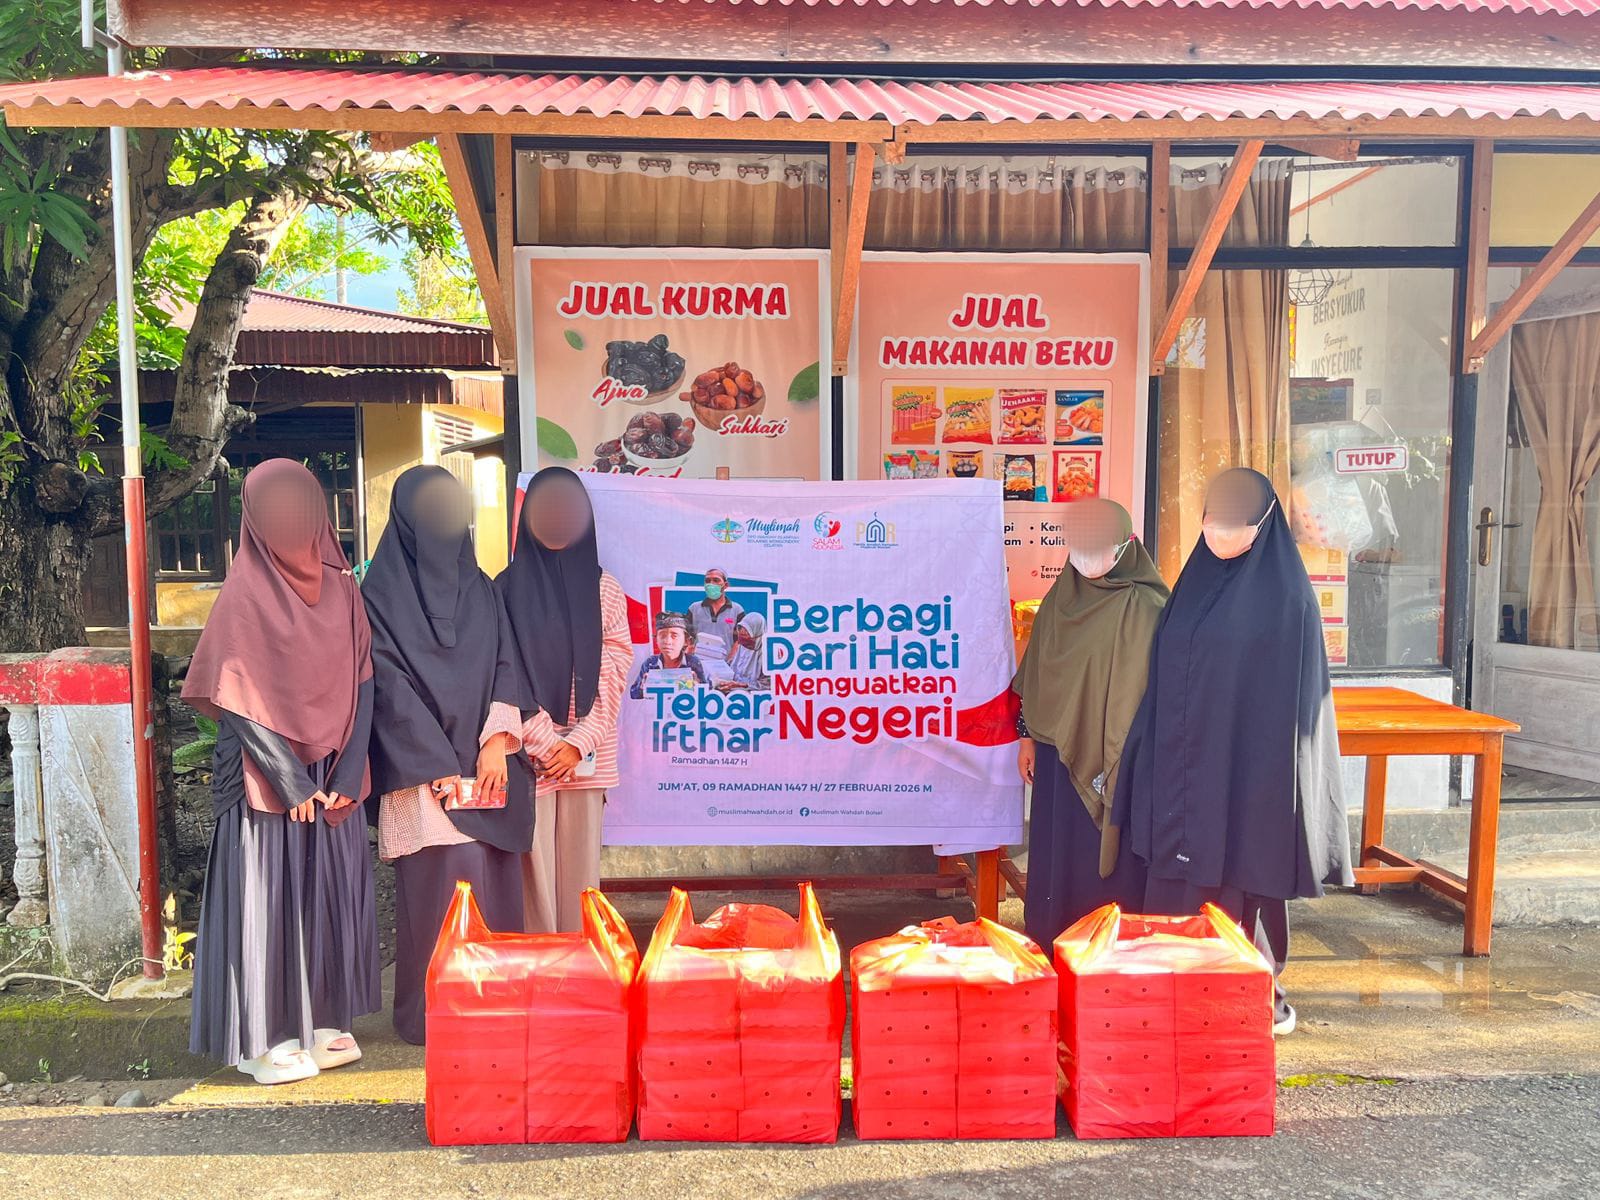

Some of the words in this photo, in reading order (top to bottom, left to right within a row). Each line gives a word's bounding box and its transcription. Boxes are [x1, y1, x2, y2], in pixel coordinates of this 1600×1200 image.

[561, 286, 653, 316] JUAL
[662, 286, 787, 316] KURMA
[952, 297, 1046, 328] JUAL
[1313, 288, 1366, 325] BERSYUKUR
[882, 340, 1027, 366] MAKANAN
[1035, 340, 1114, 367] BEKU
[592, 379, 645, 407] Ajwa
[719, 416, 788, 436] Sukkari
[1346, 452, 1396, 466] TUTUP
[1041, 536, 1065, 546] Kulit
[773, 595, 952, 637] Berbagi
[767, 634, 857, 671] Dari
[870, 633, 959, 670] Hati
[775, 673, 956, 698] Menguatkan
[646, 687, 772, 720] Tebar
[779, 696, 952, 745] Negeri
[653, 720, 773, 754] Ifthar
[671, 756, 720, 766] Ramadhan
[722, 757, 739, 766] 1447
[740, 758, 748, 766] H
[657, 782, 700, 793] JUM'AT,
[703, 782, 716, 792] 09
[719, 783, 783, 792] RAMADHAN
[785, 783, 808, 792] 1447
[811, 782, 823, 793] H/
[825, 783, 837, 792] 27
[839, 783, 892, 793] FEBRUARI
[894, 784, 921, 793] 2026
[923, 784, 932, 793] M
[718, 808, 793, 816] muslimahwahdah.or.id
